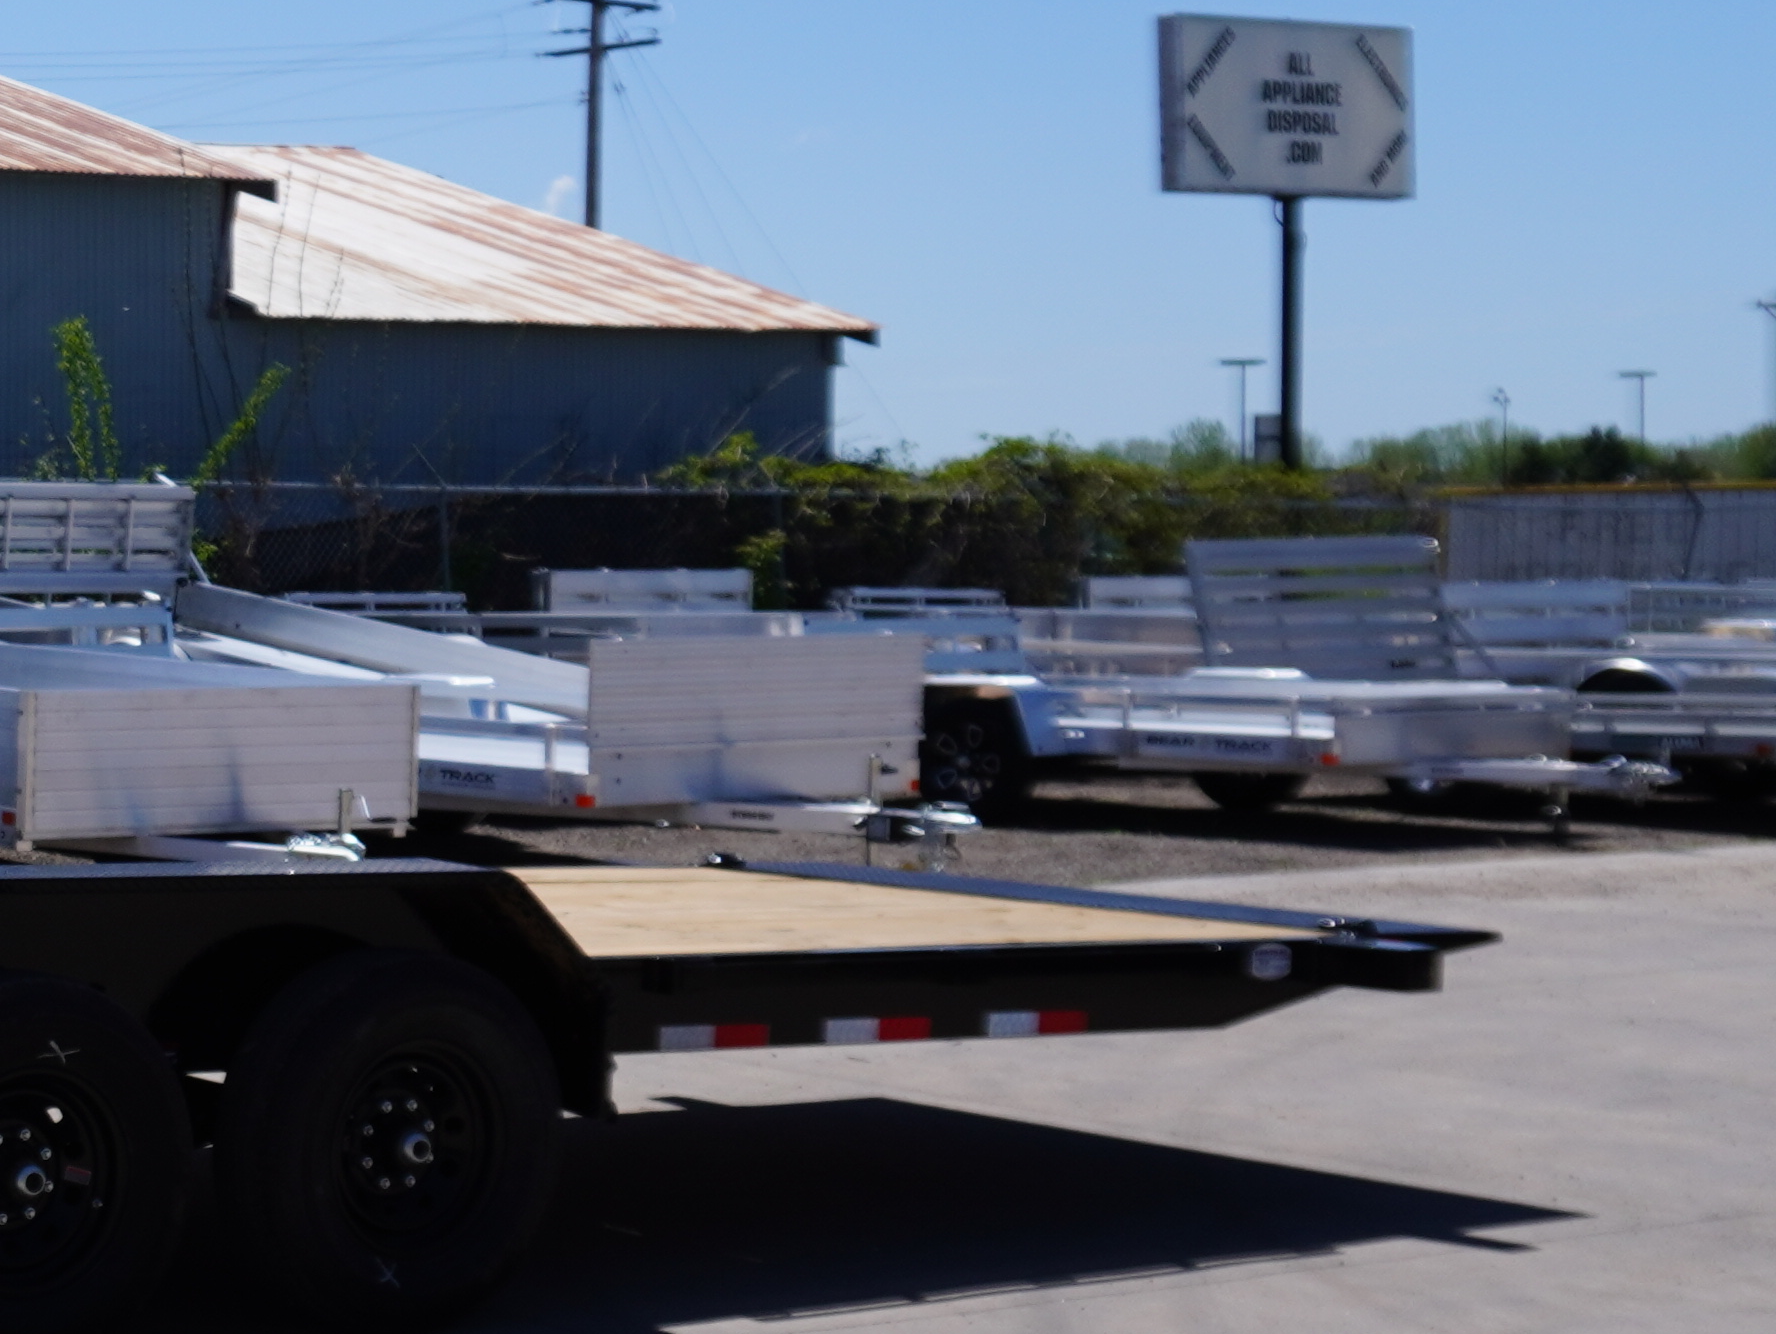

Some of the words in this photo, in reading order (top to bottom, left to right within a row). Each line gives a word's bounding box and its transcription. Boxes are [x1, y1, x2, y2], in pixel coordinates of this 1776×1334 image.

[1287, 51, 1315, 76] ALL
[1262, 79, 1343, 107] APPLIANCE
[1266, 109, 1340, 136] DISPOSAL
[1286, 140, 1323, 165] .COM
[439, 769, 495, 783] TRACK
